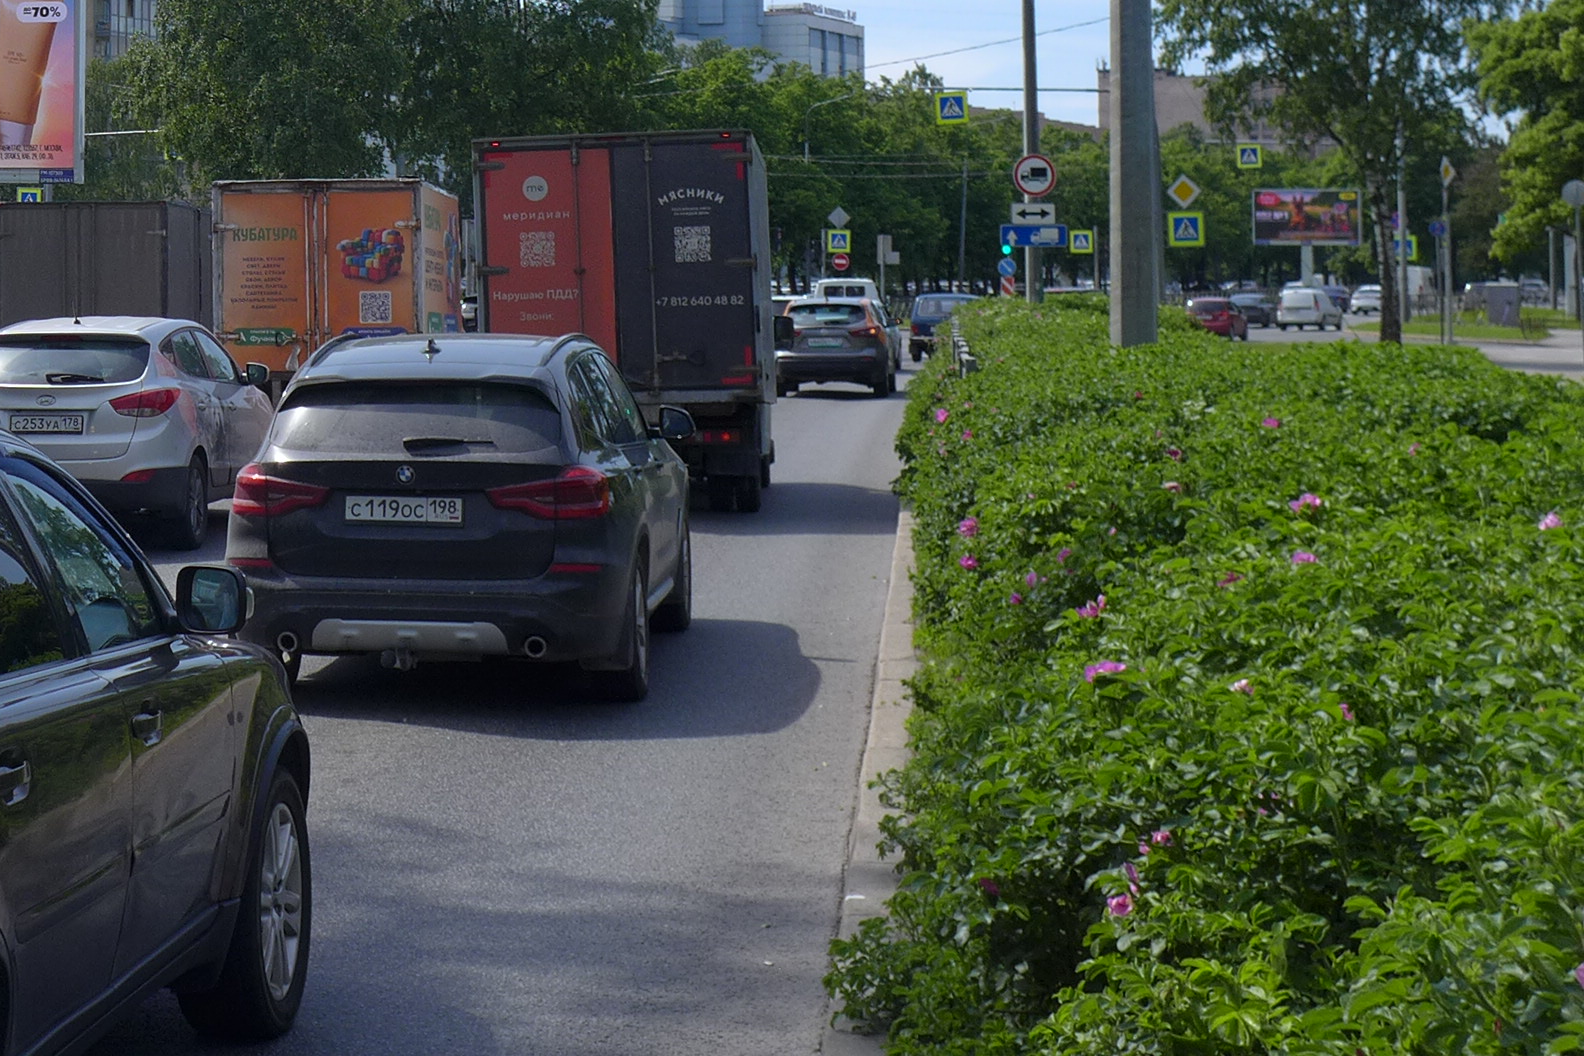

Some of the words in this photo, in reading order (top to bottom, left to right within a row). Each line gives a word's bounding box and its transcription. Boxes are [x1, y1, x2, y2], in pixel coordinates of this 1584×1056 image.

[657, 188, 725, 205] МЯСНИКИ
[503, 210, 570, 221] меридиан
[232, 227, 298, 242] КУБАТУРА
[493, 291, 544, 302] Нарушаю
[547, 289, 579, 300] ПДД?
[656, 297, 668, 306] +7
[671, 297, 688, 306] 812
[691, 296, 712, 305] 640
[714, 296, 728, 305] 48
[730, 295, 745, 304] 82
[14, 418, 59, 430] С253УА
[62, 418, 79, 428] 178
[351, 499, 424, 518] С119ОС
[430, 500, 457, 514] 198
